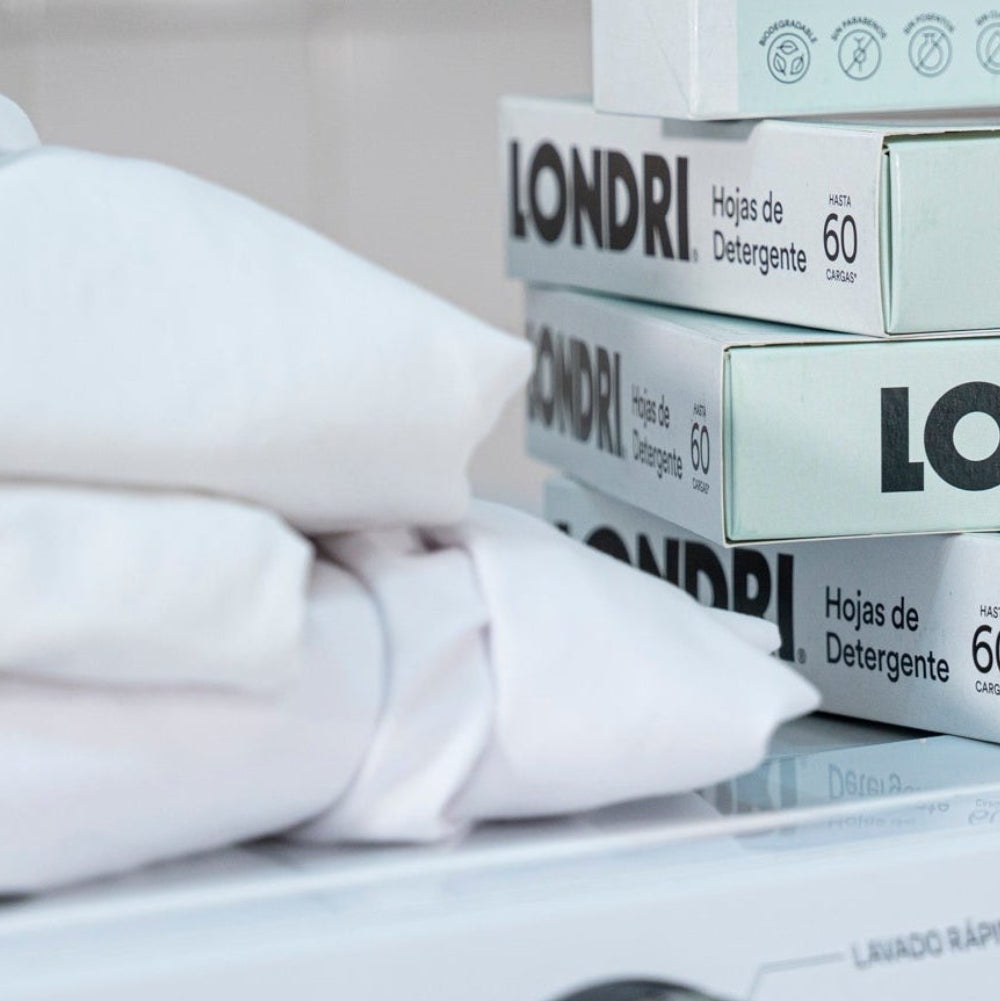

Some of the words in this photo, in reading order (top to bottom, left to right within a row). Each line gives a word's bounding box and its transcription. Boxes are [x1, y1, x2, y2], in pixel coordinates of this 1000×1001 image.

[758, 19, 818, 47] BIODEGRADABLE
[712, 185, 758, 227] Hojas
[762, 190, 783, 224] de
[828, 194, 852, 207] HASTA
[713, 230, 807, 276] Detergente
[823, 213, 858, 264] 60
[632, 385, 656, 429] Hojas
[658, 395, 670, 429] de
[633, 428, 683, 480] Detergente
[690, 421, 710, 475] 60
[825, 585, 885, 632] Hojas
[891, 596, 919, 632] de
[825, 631, 950, 684] Detergente
[851, 928, 944, 970] LAVADO
